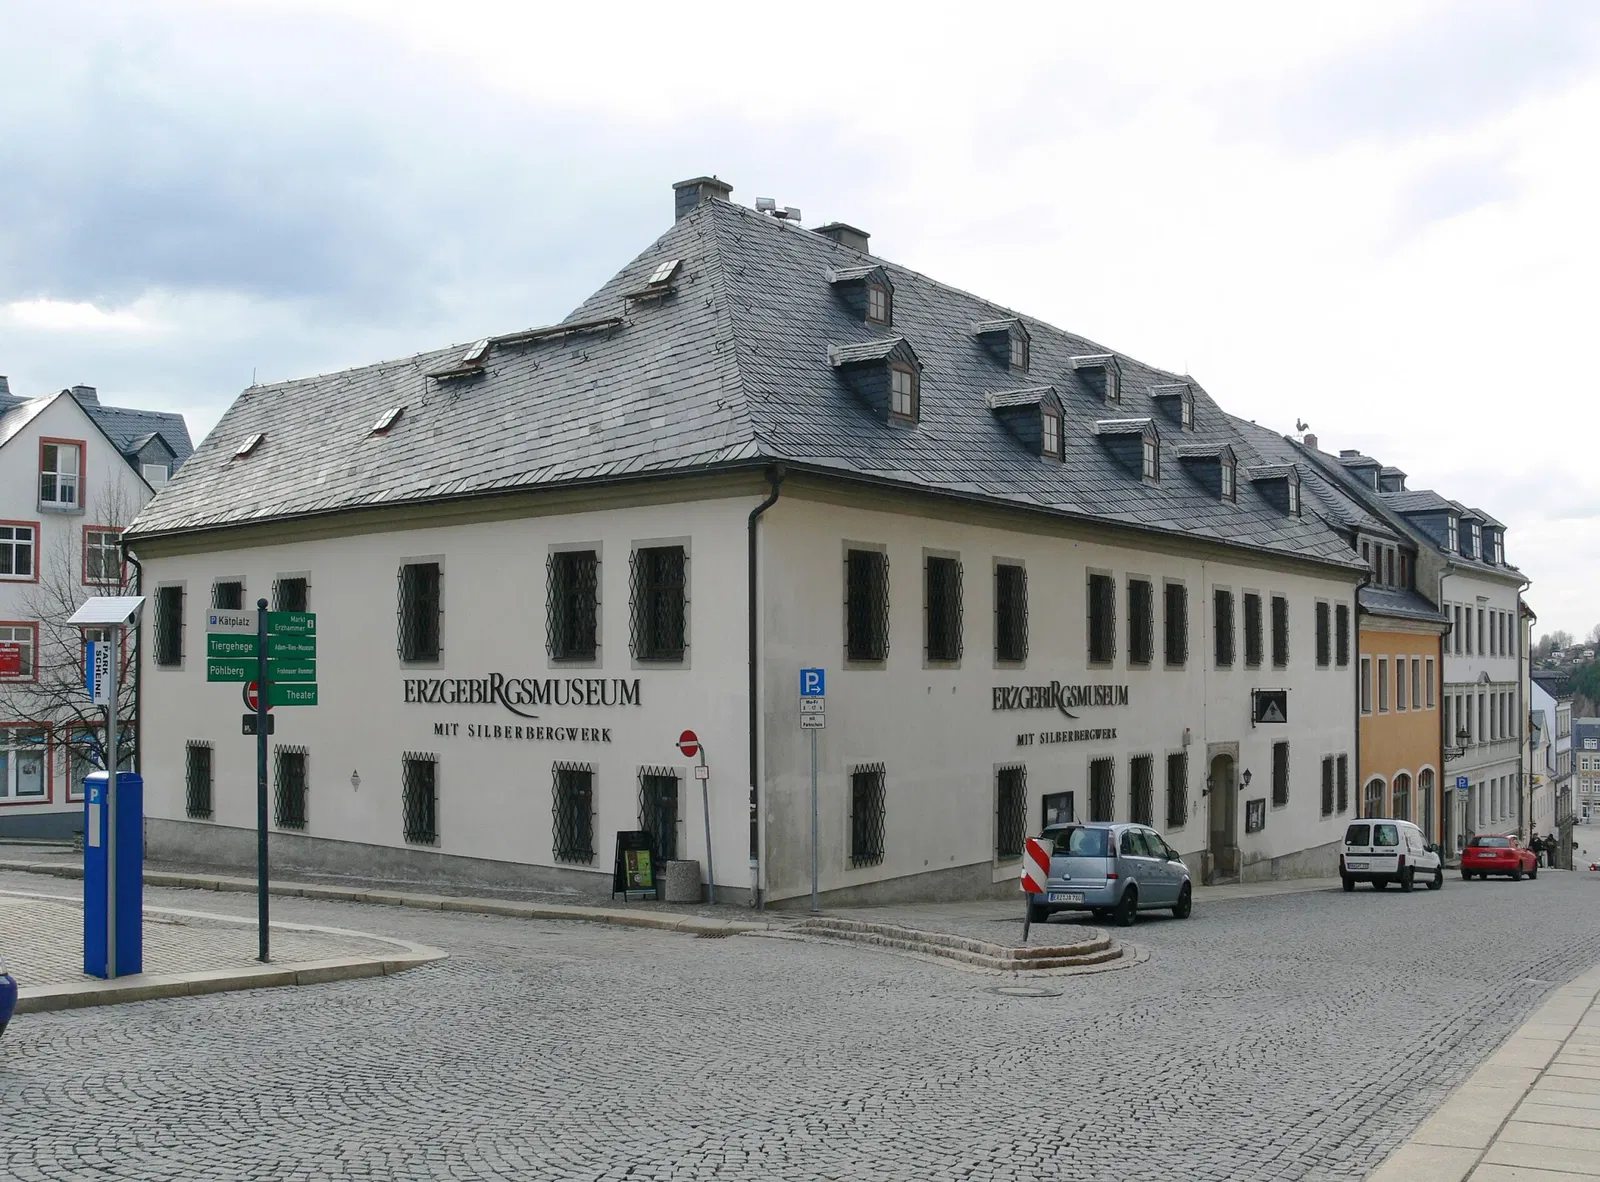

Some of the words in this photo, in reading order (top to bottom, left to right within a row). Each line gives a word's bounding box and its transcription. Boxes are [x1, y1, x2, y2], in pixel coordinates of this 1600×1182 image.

[219, 616, 250, 628] Kätplatz
[275, 624, 306, 632] Erzhammer
[210, 641, 253, 653] Tiergehege
[210, 665, 245, 677] Pöhlberg
[805, 672, 819, 693] P
[286, 689, 316, 700] Theater
[403, 672, 642, 719] ERZGEBIRGSMUSEUM
[992, 680, 1129, 719] ERZGEBIRGSMUSEUM
[433, 722, 459, 737] MIT
[468, 723, 613, 744] SILBERBERGWERK
[1016, 733, 1035, 747] MIT
[1040, 727, 1118, 745] SILBERBERGWERK
[90, 788, 99, 802] P
